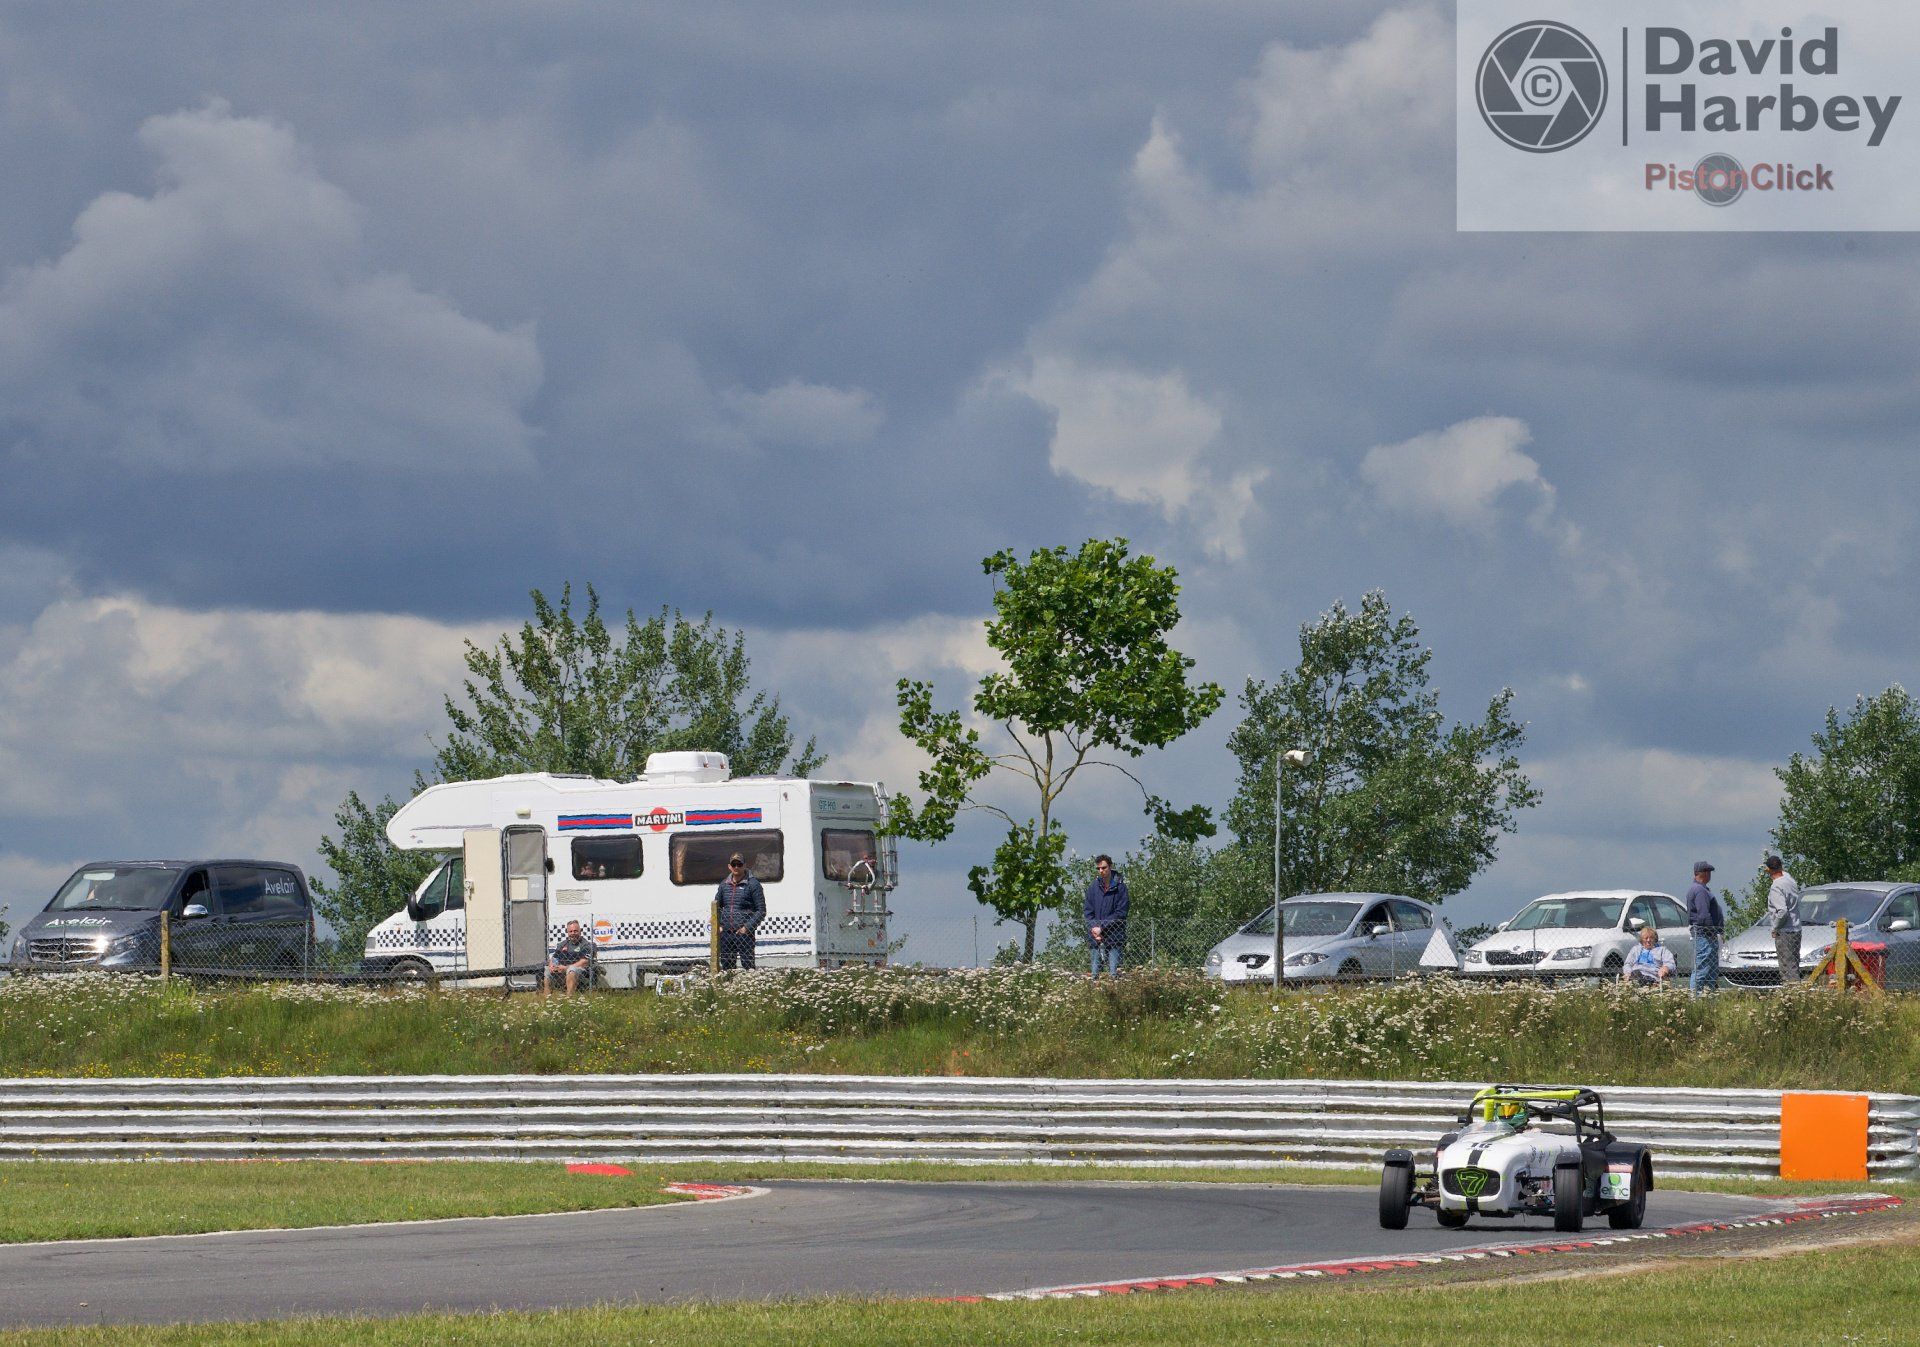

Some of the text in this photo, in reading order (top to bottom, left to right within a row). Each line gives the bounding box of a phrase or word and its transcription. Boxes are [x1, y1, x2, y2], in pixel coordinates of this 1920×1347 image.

[636, 813, 682, 826] MARTINI
[264, 877, 295, 894] Avelair
[45, 916, 113, 927] Avelair
[1601, 1186, 1629, 1197] emc
